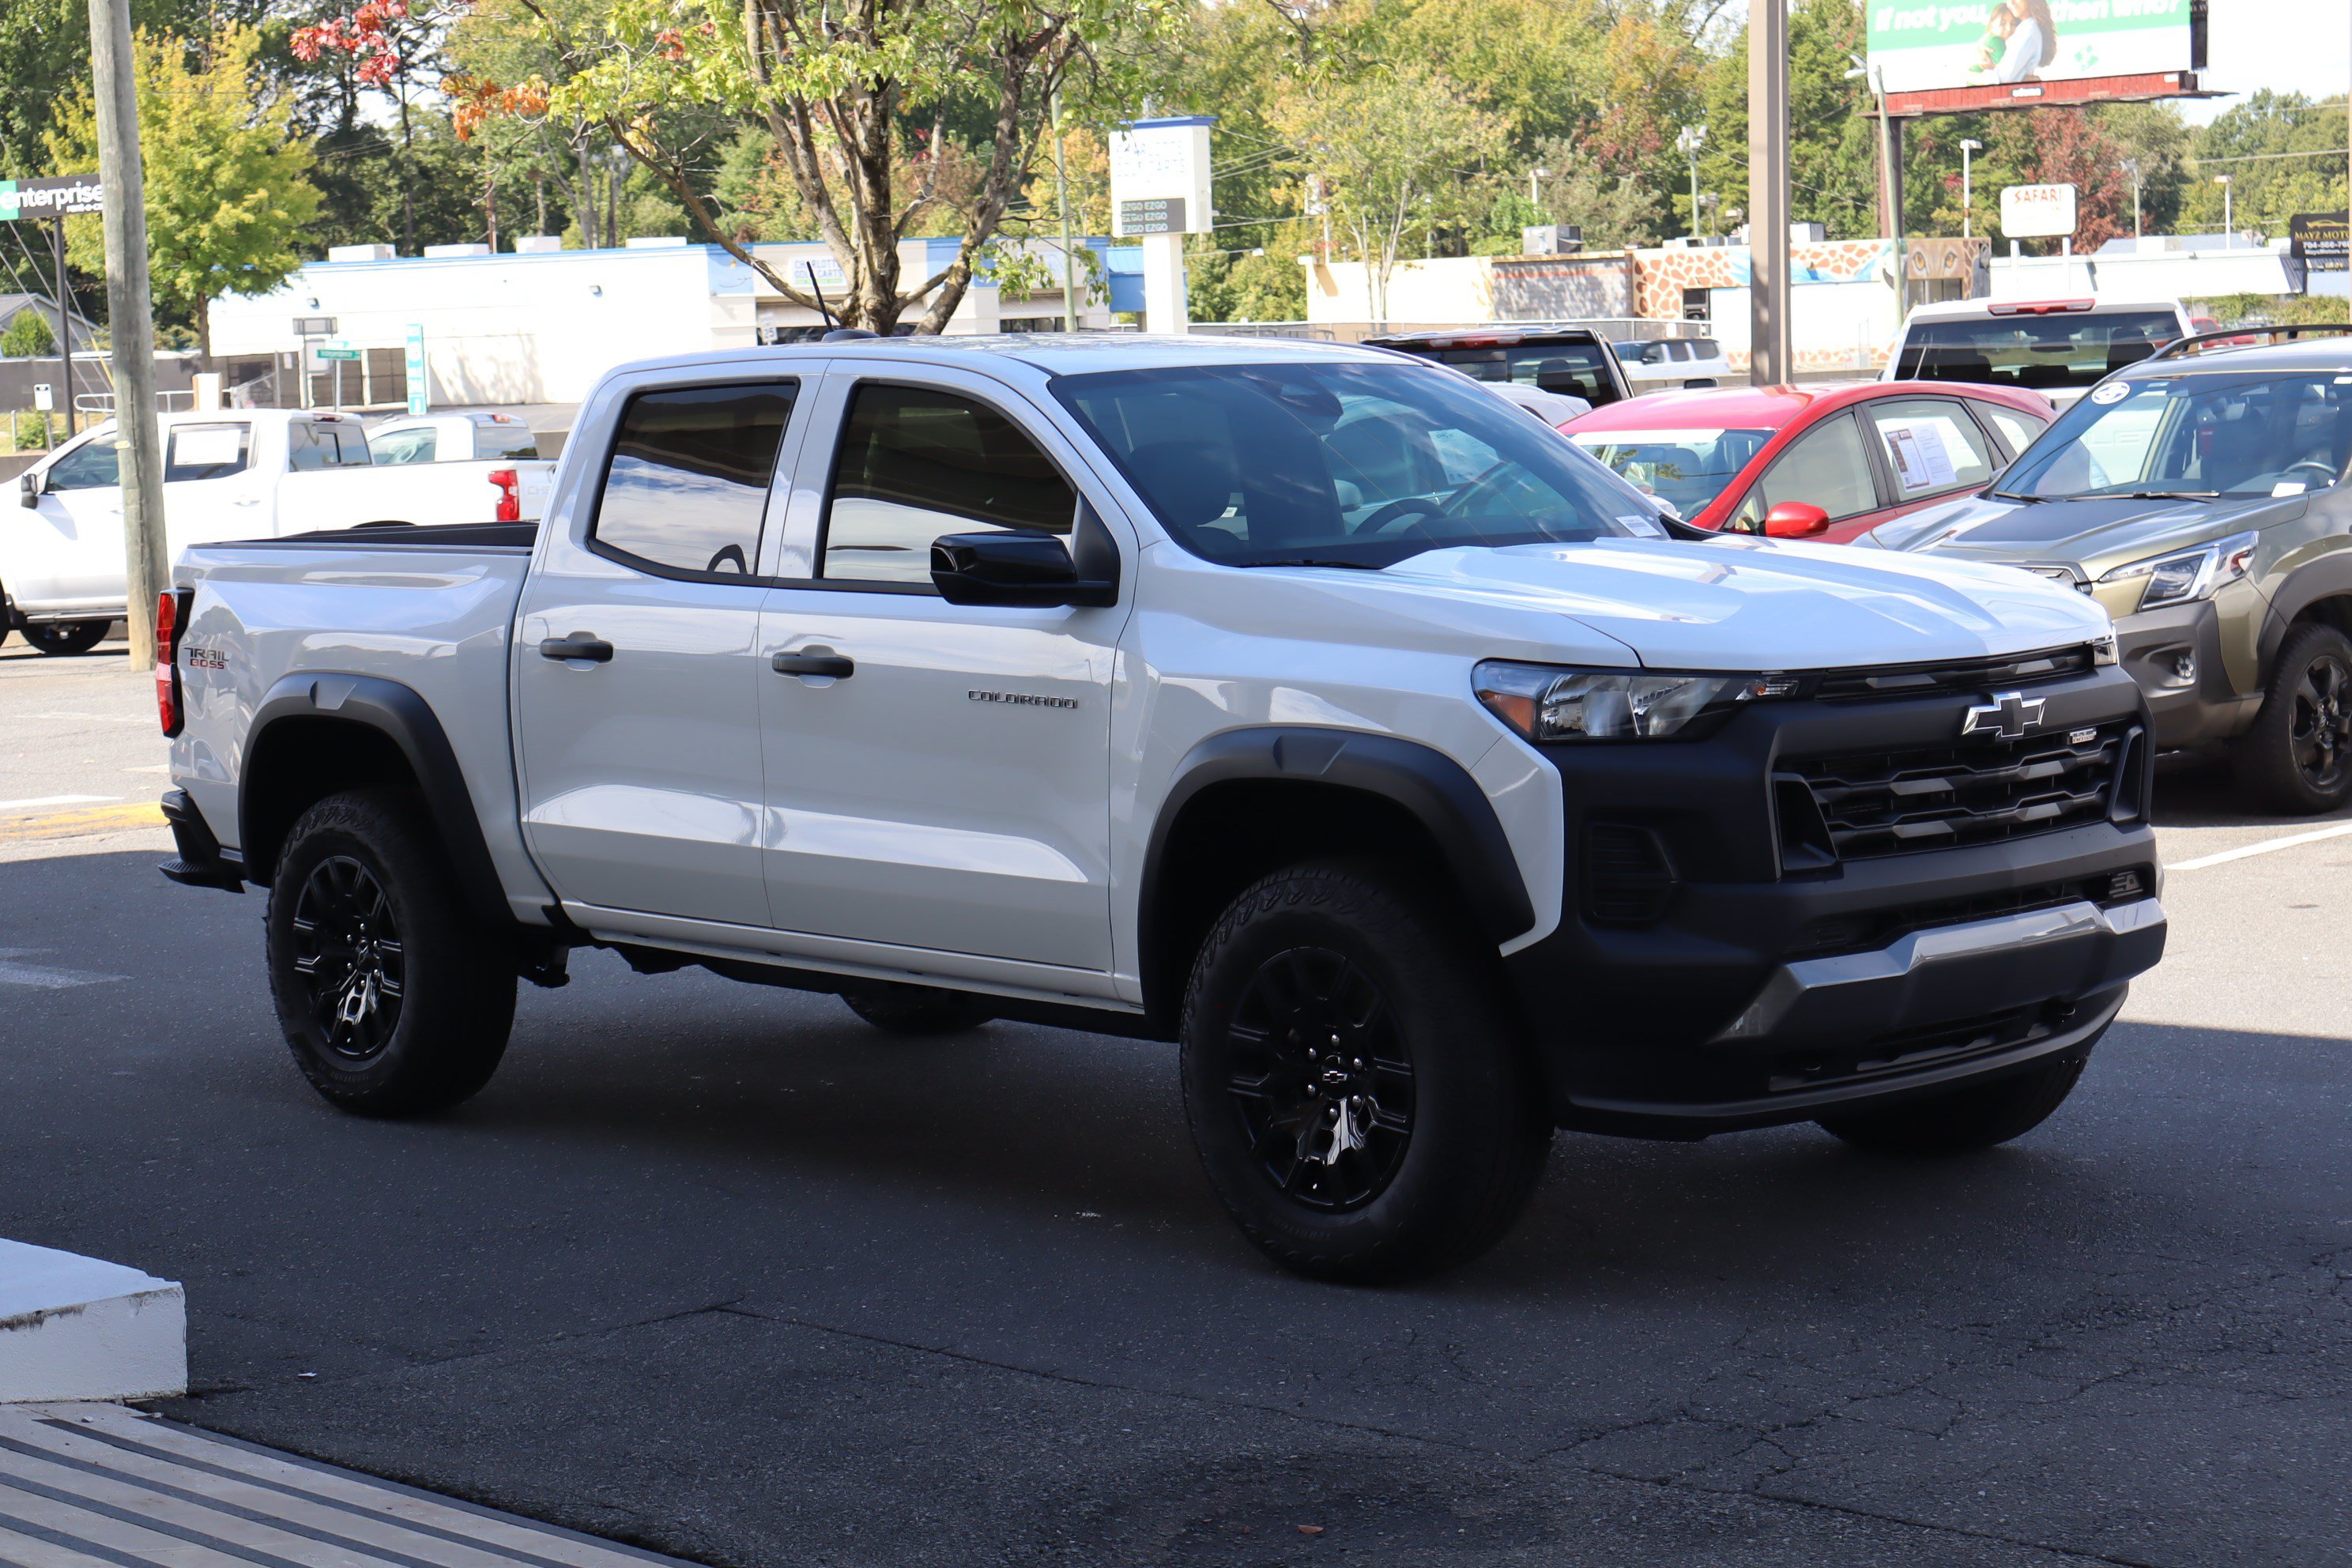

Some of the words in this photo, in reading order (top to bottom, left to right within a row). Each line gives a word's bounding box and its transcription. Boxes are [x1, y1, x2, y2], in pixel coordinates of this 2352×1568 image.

[1875, 6, 1894, 32] If
[1894, 5, 1937, 29] not
[1939, 4, 1991, 32] you,
[0, 181, 103, 211] enterprise
[2015, 188, 2062, 203] SAFARI
[1144, 201, 1167, 210] EZGO
[1144, 212, 1168, 221] EZGO
[1145, 223, 1169, 232] EZGO
[2294, 231, 2320, 240] MAYZ
[184, 647, 229, 662] TRAIL
[190, 658, 224, 669] BOSS
[968, 689, 1078, 709] COLORADO
